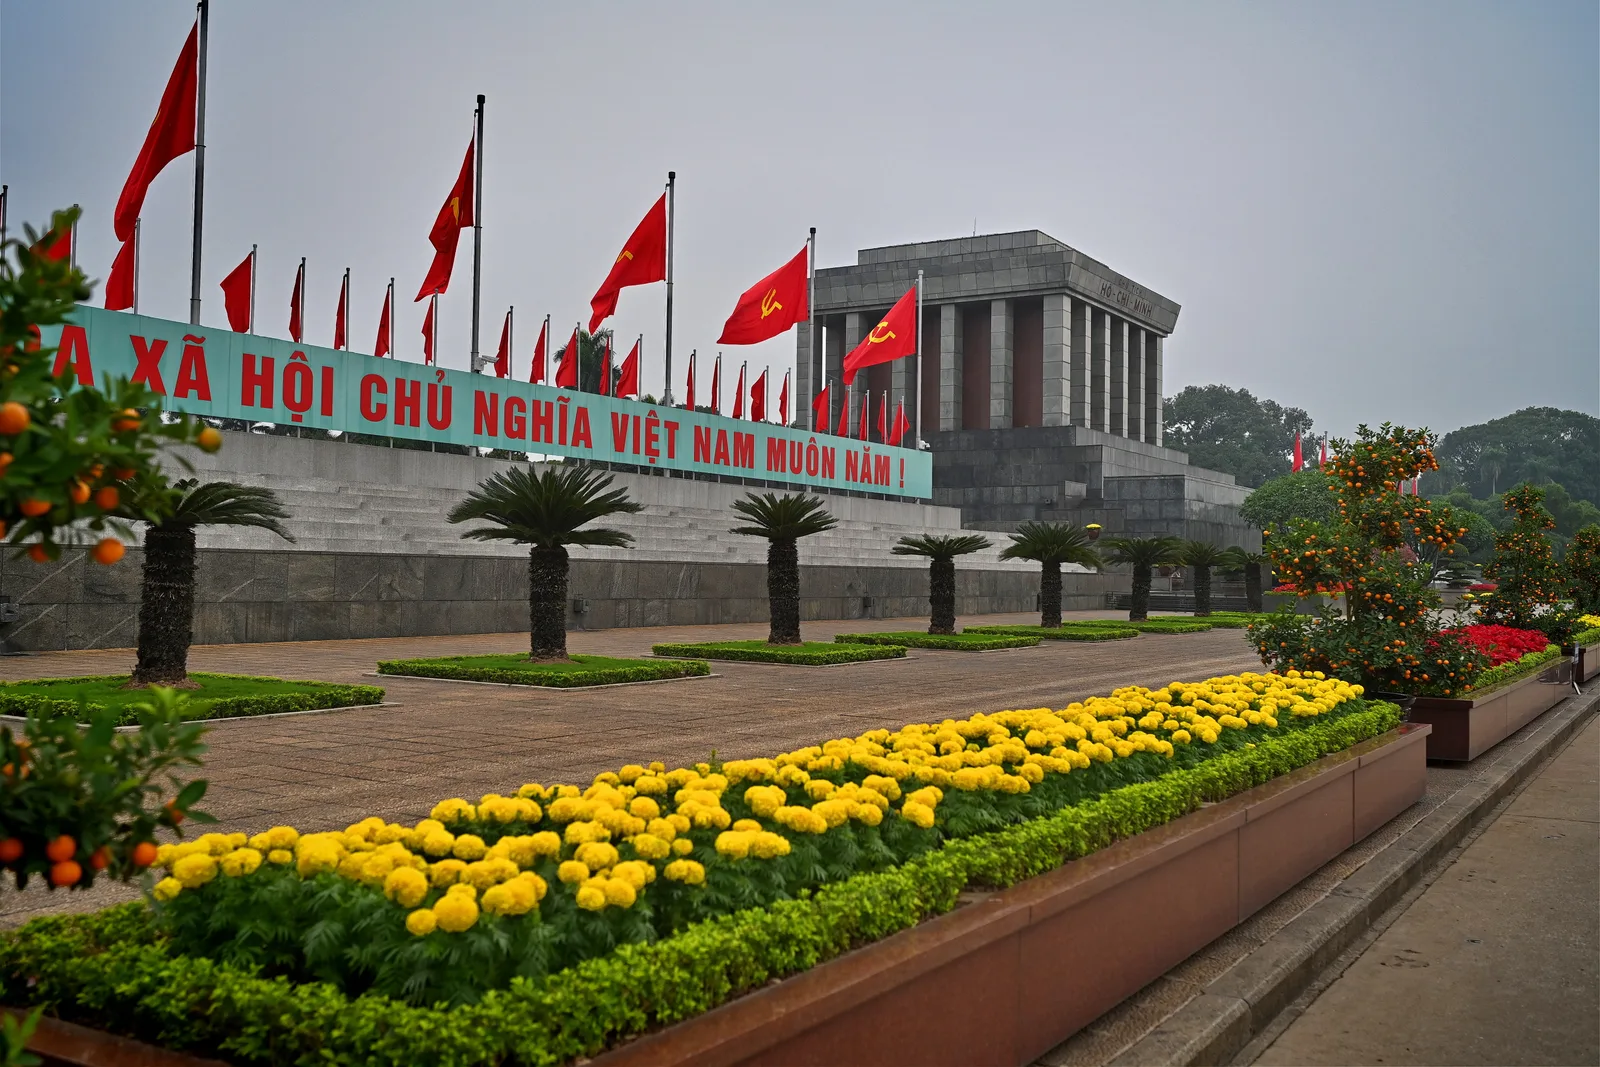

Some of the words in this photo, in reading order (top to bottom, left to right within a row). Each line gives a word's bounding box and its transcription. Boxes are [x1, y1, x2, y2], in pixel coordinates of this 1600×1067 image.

[131, 334, 212, 401] XÃ
[241, 351, 334, 422] HỘI
[359, 369, 453, 431] CHỦ
[473, 390, 593, 449] NGHĨA
[611, 409, 680, 464] VIỆT
[693, 426, 755, 469] NAM
[766, 436, 836, 479] MUÔN
[845, 446, 891, 486] NĂM
